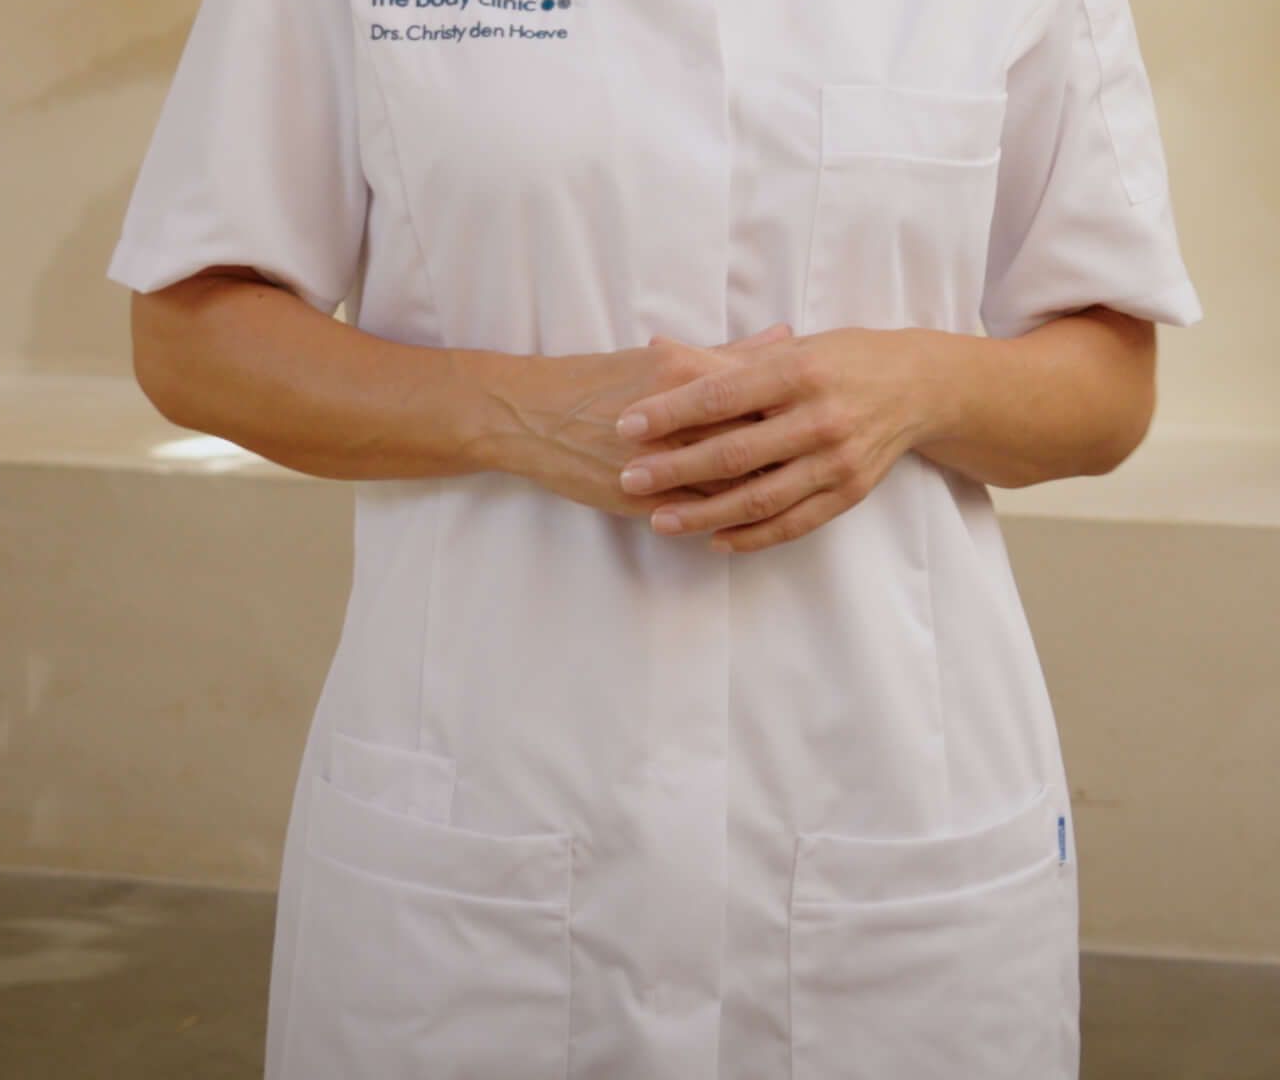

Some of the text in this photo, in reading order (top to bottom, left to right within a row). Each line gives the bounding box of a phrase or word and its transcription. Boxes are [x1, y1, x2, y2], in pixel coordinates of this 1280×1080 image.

[371, 21, 568, 43] Drs. Christy den Hoeve
